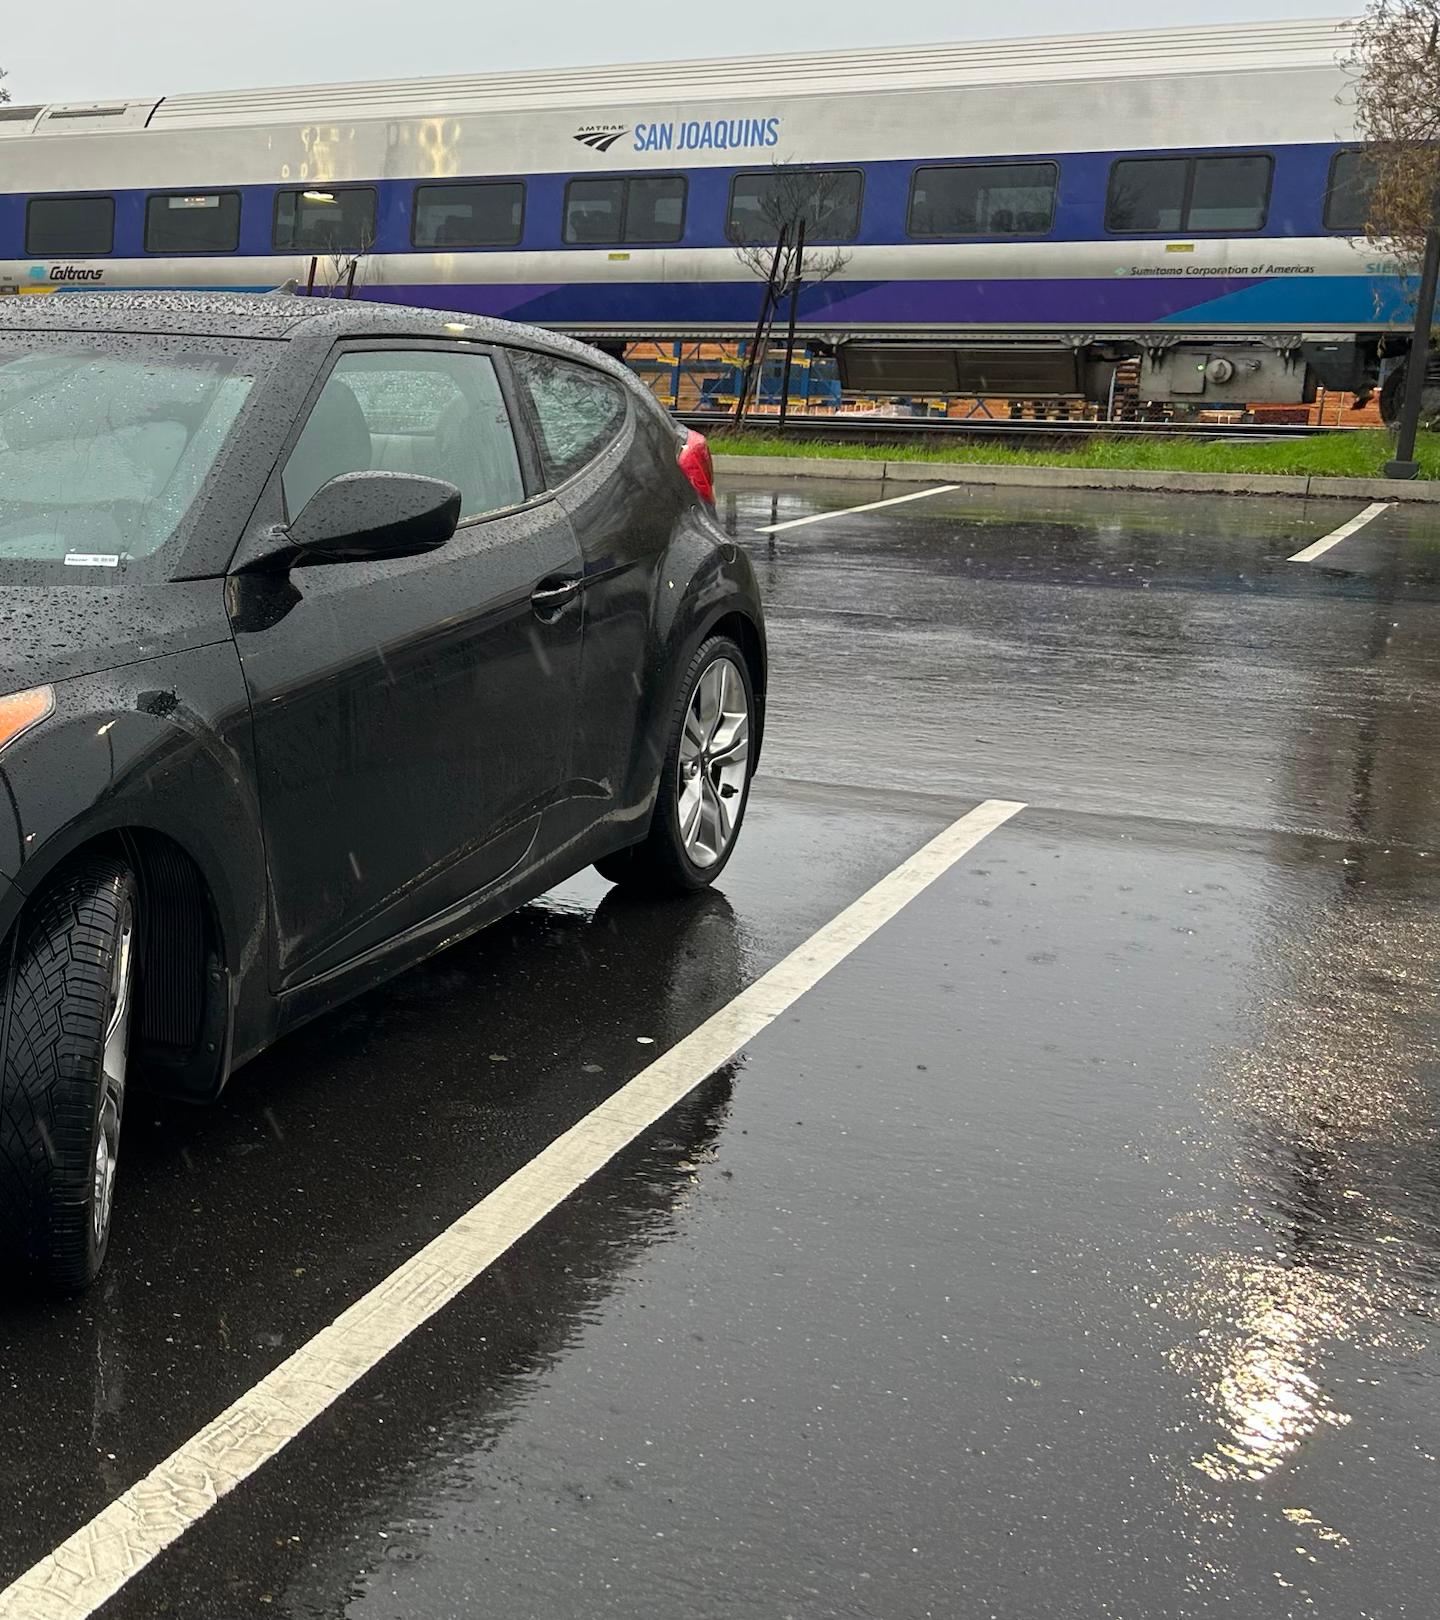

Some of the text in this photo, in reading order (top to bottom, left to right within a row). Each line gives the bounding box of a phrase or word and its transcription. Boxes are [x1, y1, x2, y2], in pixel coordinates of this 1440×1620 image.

[578, 124, 625, 132] AMTRAK
[633, 118, 780, 151] SAN JOAQUINS
[49, 265, 104, 280] Caltrans
[1130, 264, 1316, 276] Sumitomo Corporation of Americas
